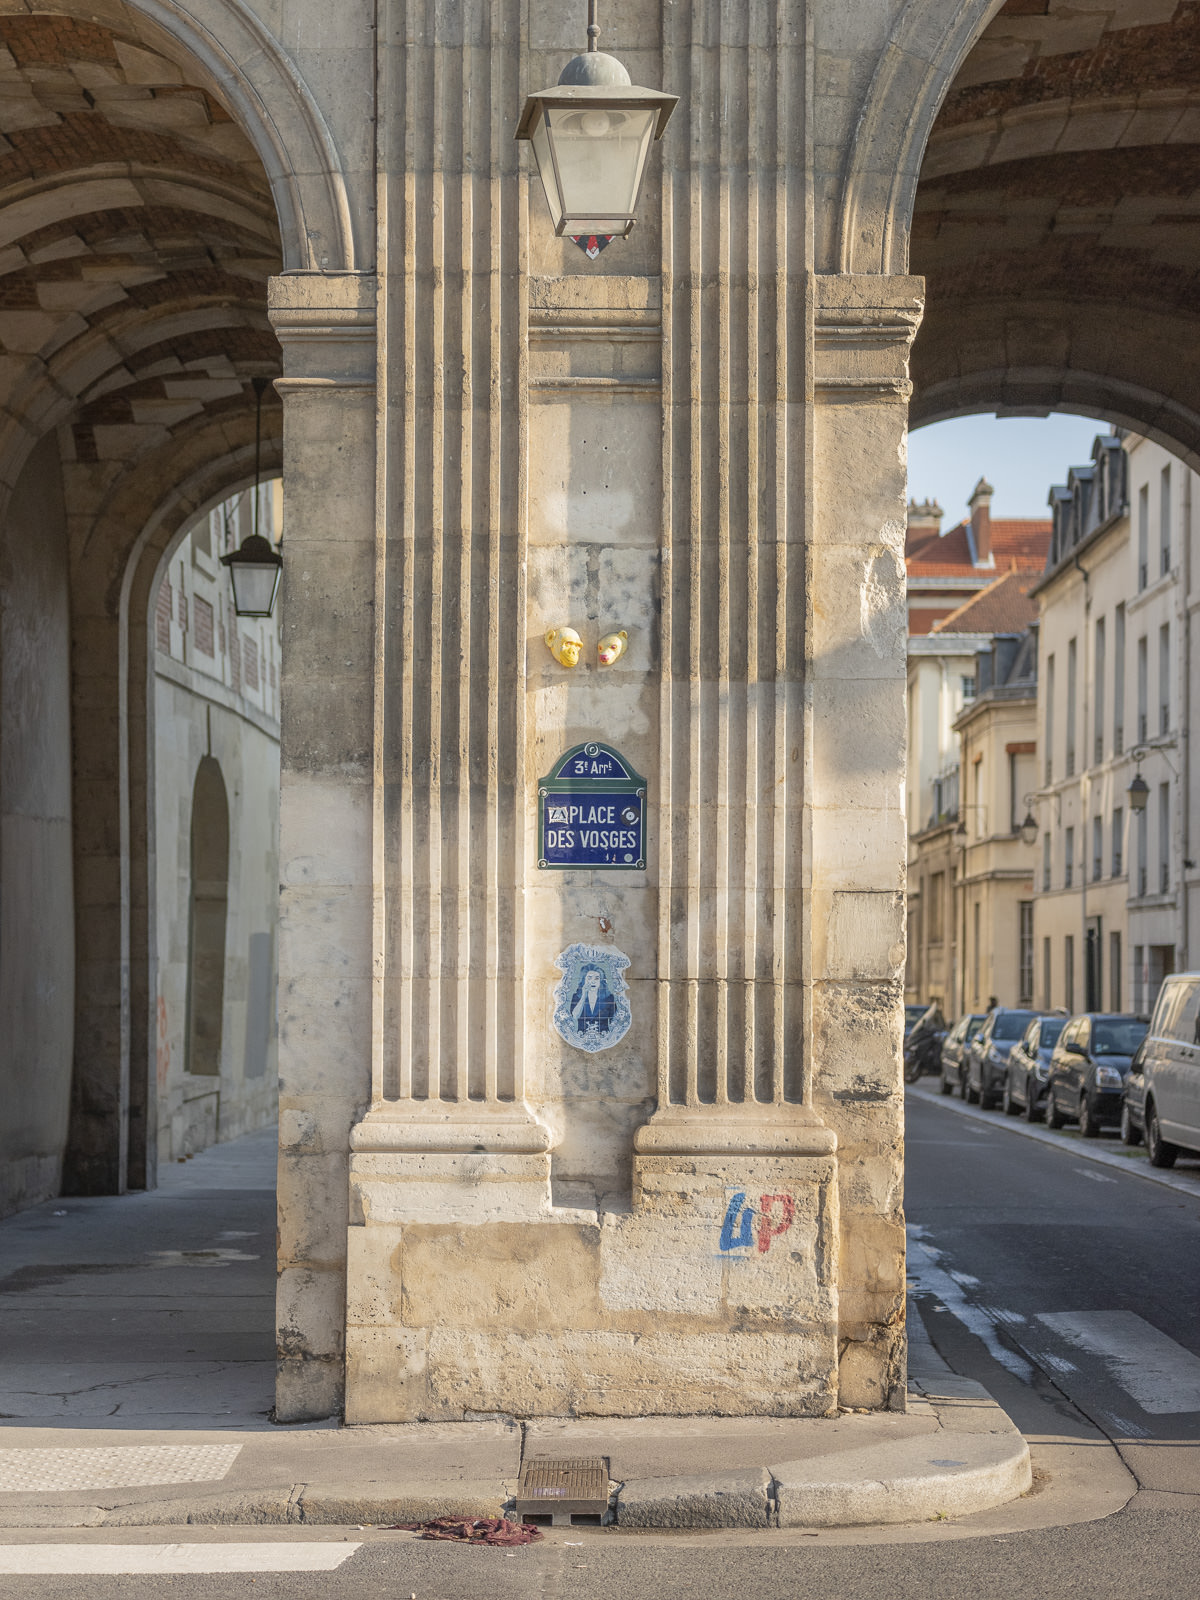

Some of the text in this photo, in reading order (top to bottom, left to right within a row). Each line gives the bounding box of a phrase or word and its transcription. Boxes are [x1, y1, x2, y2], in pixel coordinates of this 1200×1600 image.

[591, 760, 613, 775] Arrt
[569, 806, 615, 824] PLACE
[548, 830, 637, 849] DES VOSGES
